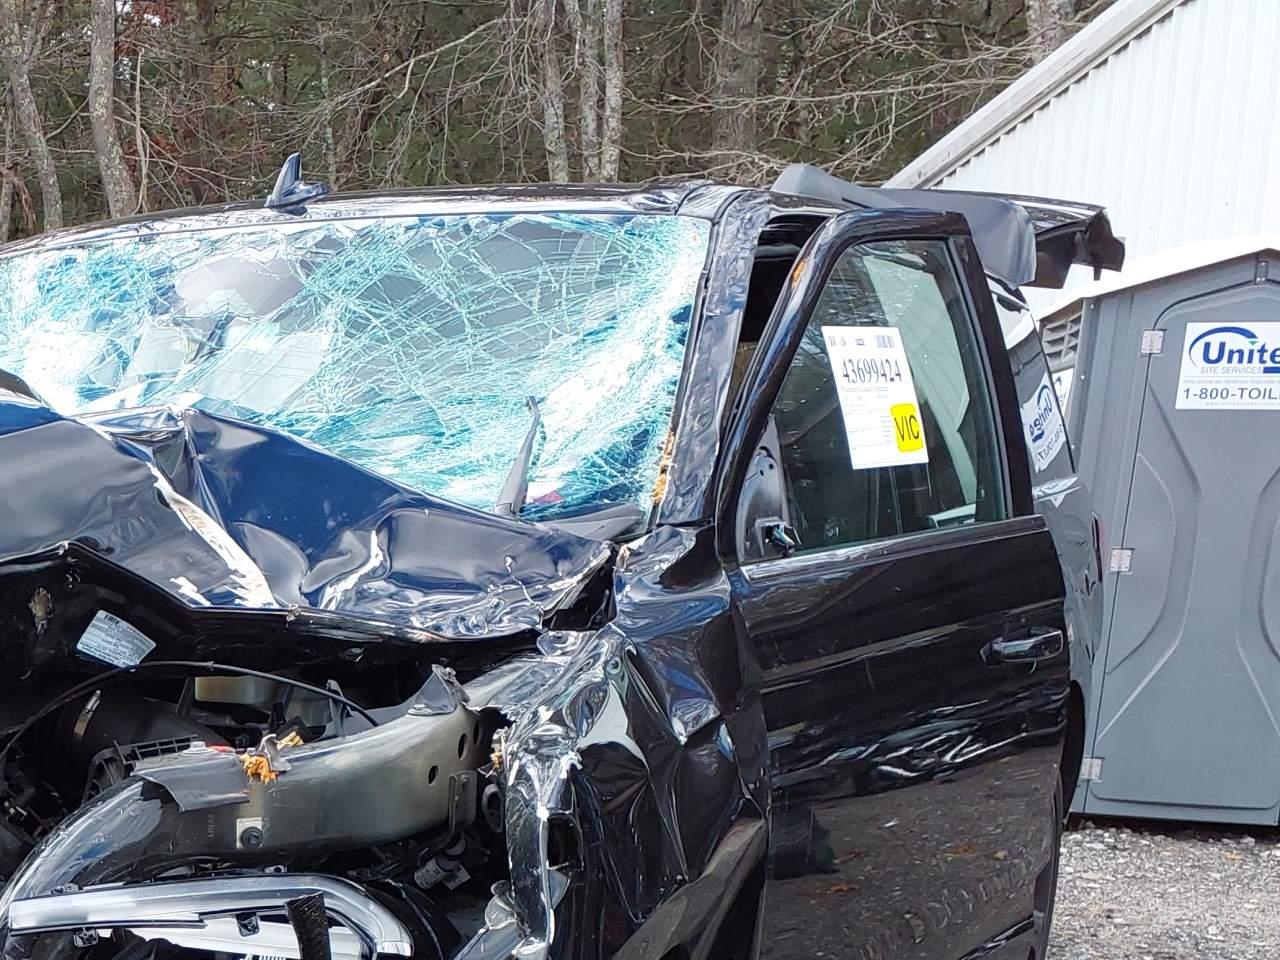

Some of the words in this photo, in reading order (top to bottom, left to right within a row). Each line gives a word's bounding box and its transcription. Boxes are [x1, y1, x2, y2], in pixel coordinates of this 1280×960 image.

[1202, 341, 1280, 365] Unite
[842, 358, 902, 384] 43699424
[1183, 387, 1280, 400] 1-800-TOIL
[894, 414, 920, 442] VIC
